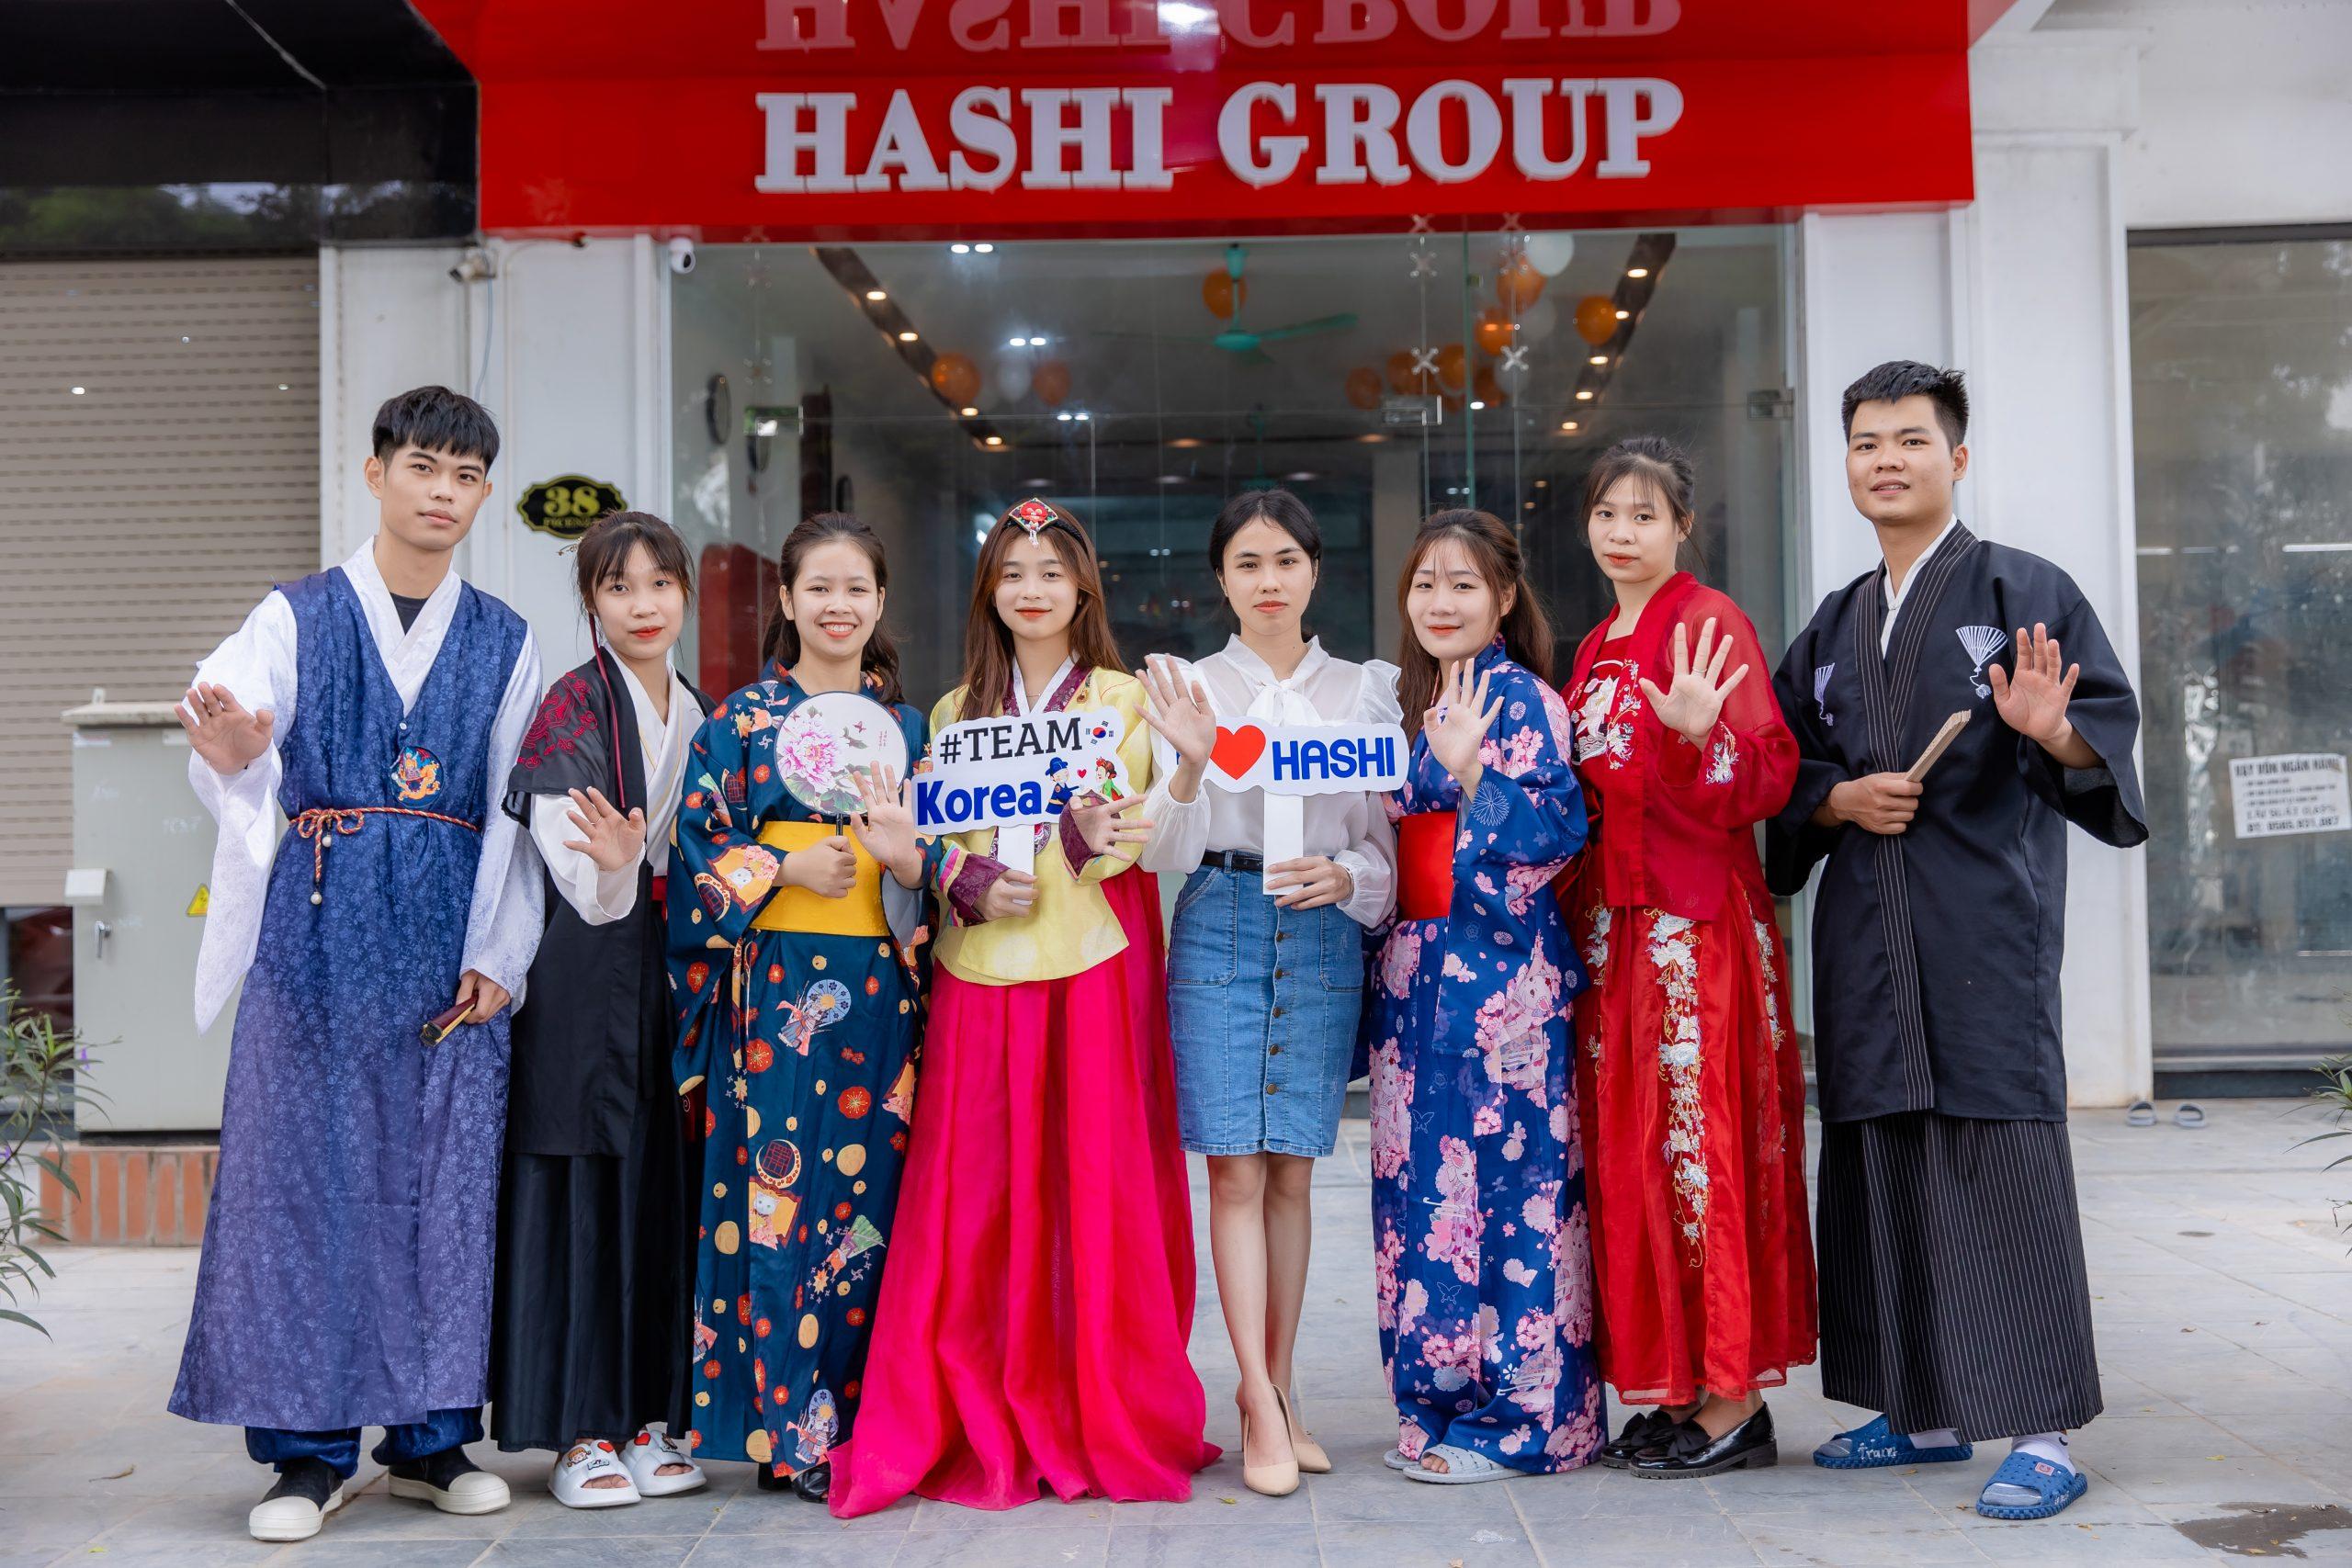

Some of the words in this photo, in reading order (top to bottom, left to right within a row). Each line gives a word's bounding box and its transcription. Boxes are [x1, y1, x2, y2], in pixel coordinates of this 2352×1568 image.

[754, 86, 1174, 193] HASHI
[1217, 77, 1685, 189] GROUP
[544, 486, 601, 517] 38
[939, 716, 1083, 764] #TEAM
[1272, 737, 1396, 781] HASHI
[917, 780, 1042, 826] Korea
